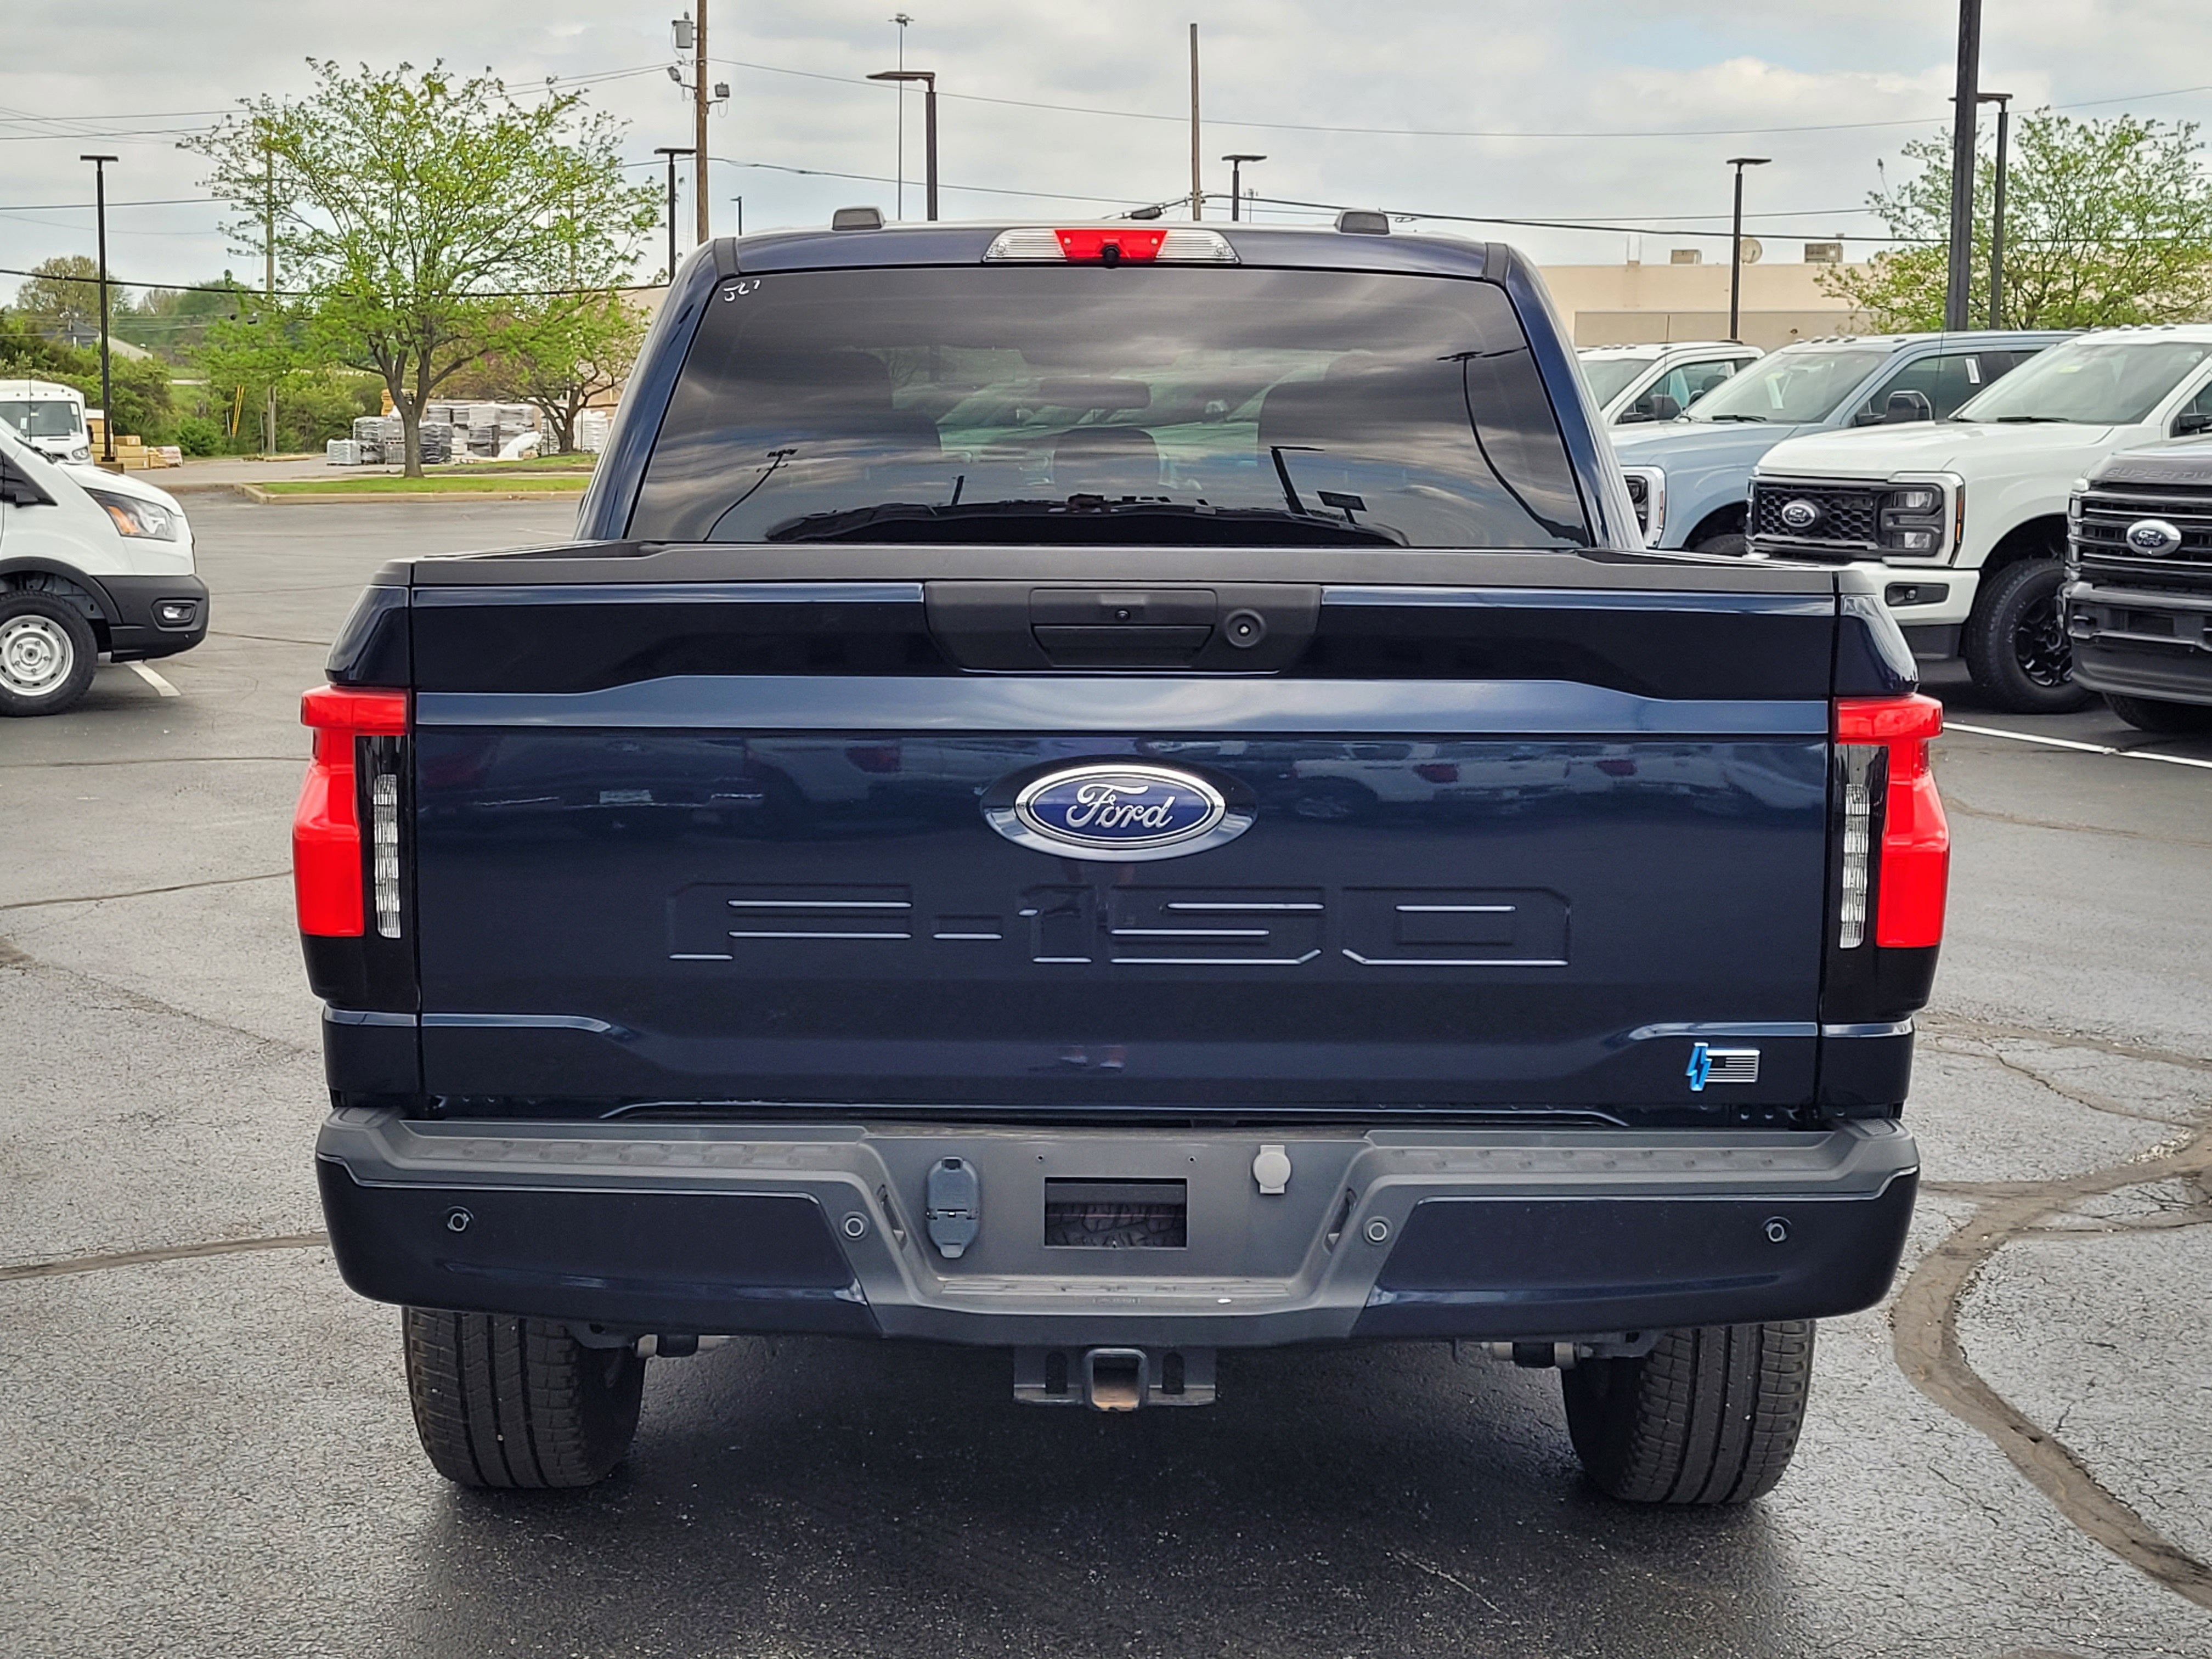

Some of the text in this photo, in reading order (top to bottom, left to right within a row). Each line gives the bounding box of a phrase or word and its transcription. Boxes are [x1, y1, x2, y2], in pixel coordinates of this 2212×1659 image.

[2104, 467, 2212, 482] SUPER DU
[2136, 529, 2163, 546] Ford
[1065, 783, 1176, 828] Ford
[666, 883, 1571, 968] F-150
